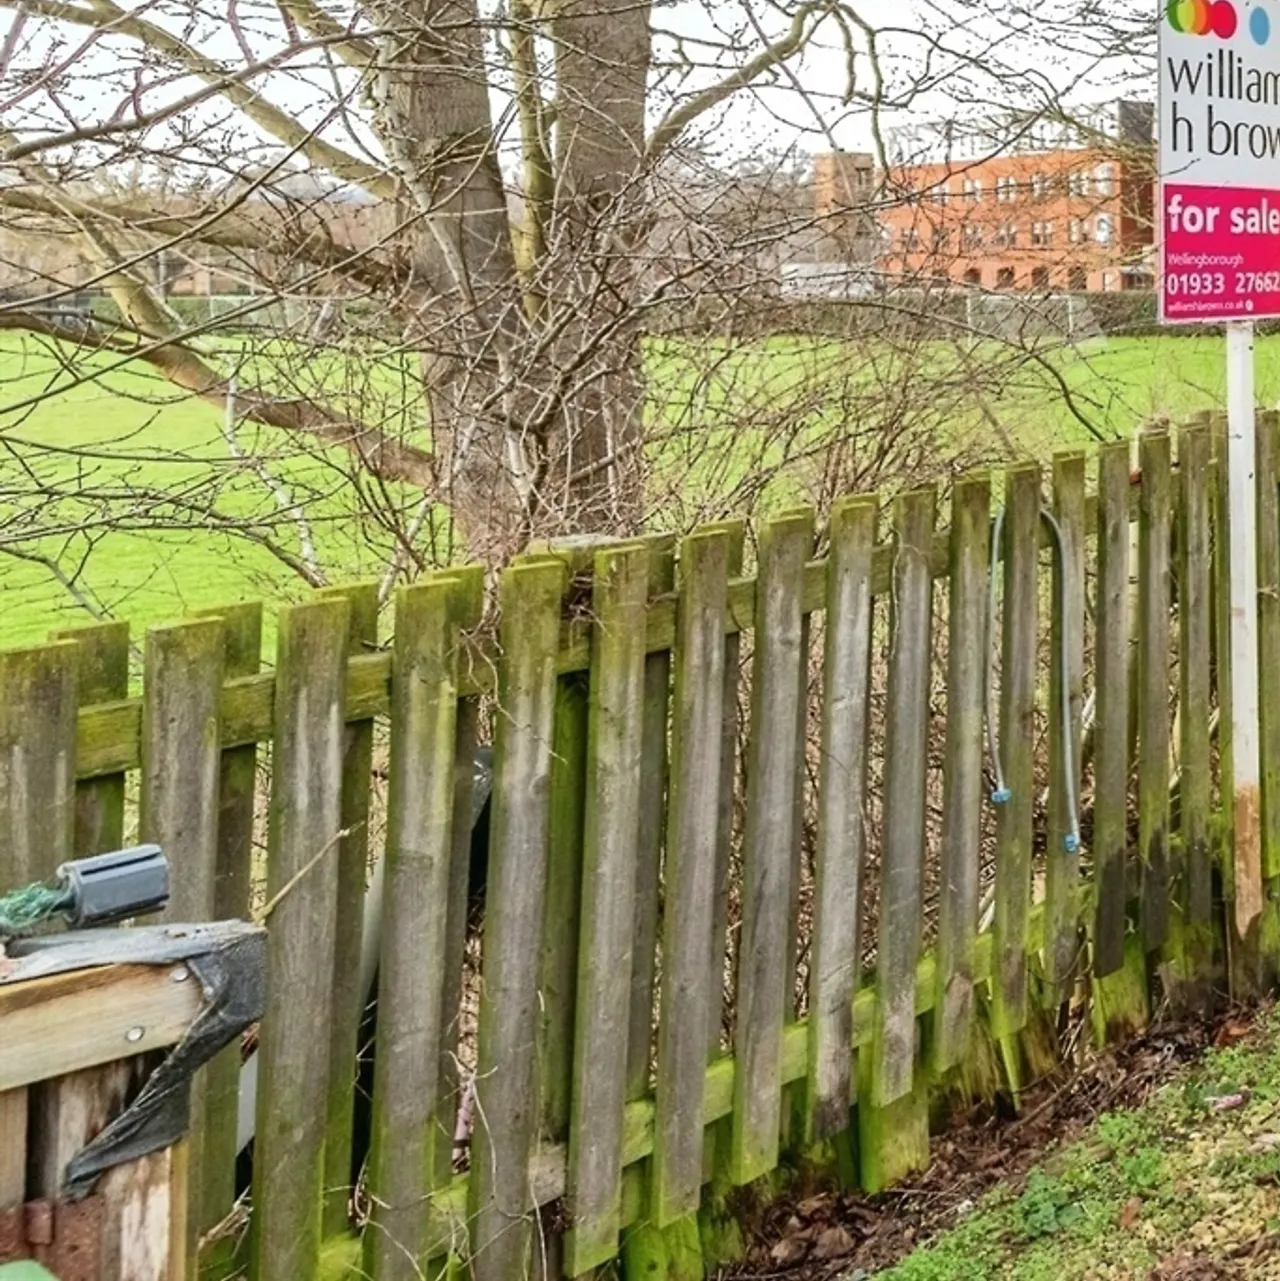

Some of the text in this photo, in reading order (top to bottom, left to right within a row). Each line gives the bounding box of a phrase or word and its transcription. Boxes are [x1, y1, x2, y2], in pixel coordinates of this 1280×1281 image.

[1171, 100, 1194, 153] h
[1167, 194, 1220, 233] for
[1167, 252, 1245, 270] Wellingborough
[1167, 272, 1225, 296] 01933
